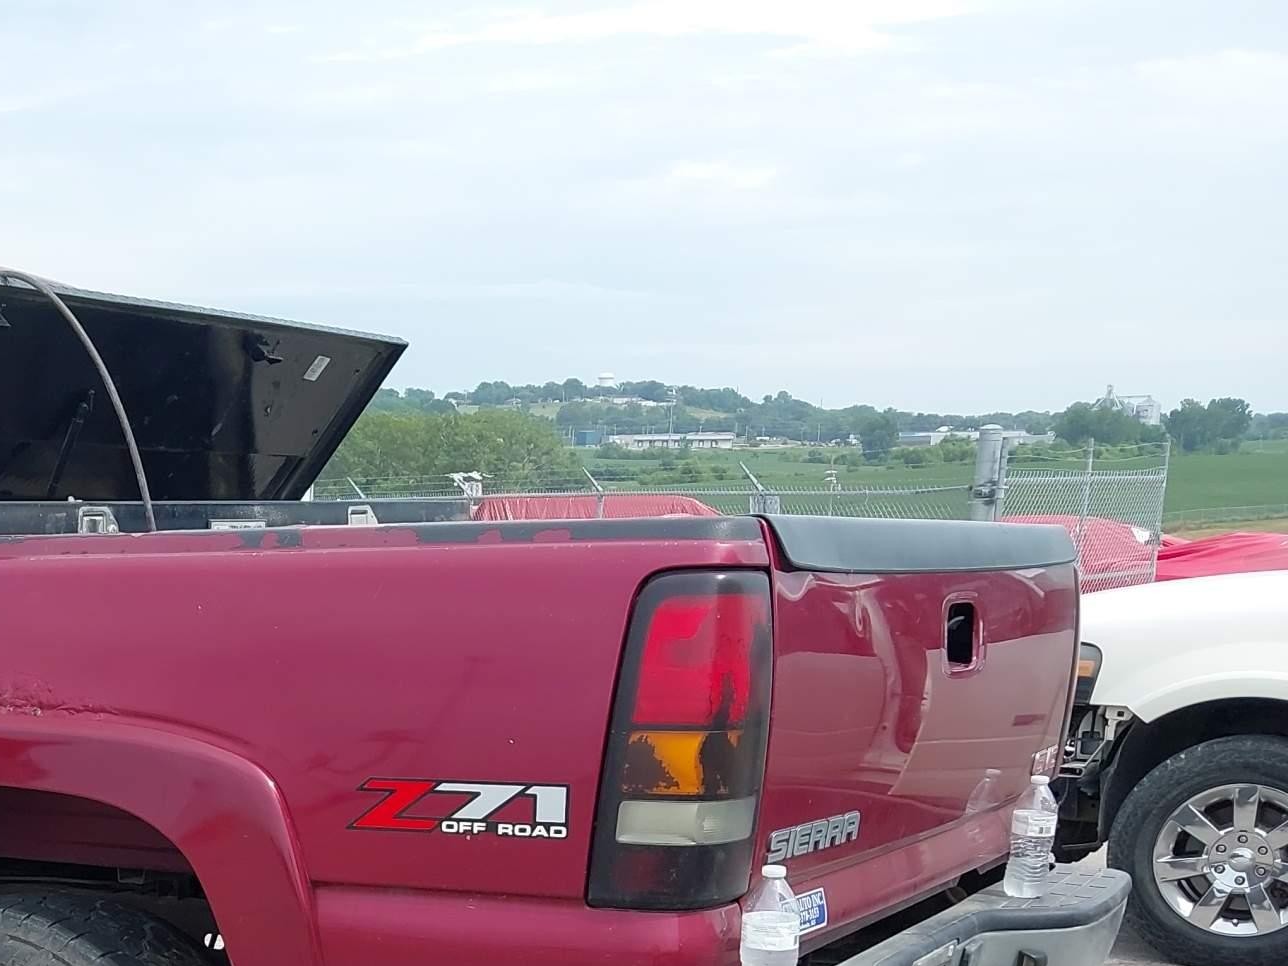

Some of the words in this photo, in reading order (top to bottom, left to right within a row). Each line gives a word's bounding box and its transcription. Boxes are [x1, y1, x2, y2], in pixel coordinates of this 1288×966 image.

[347, 776, 569, 833] Z71
[441, 820, 486, 834] OFF
[497, 823, 567, 838] ROAD
[766, 809, 861, 864] SIERRA
